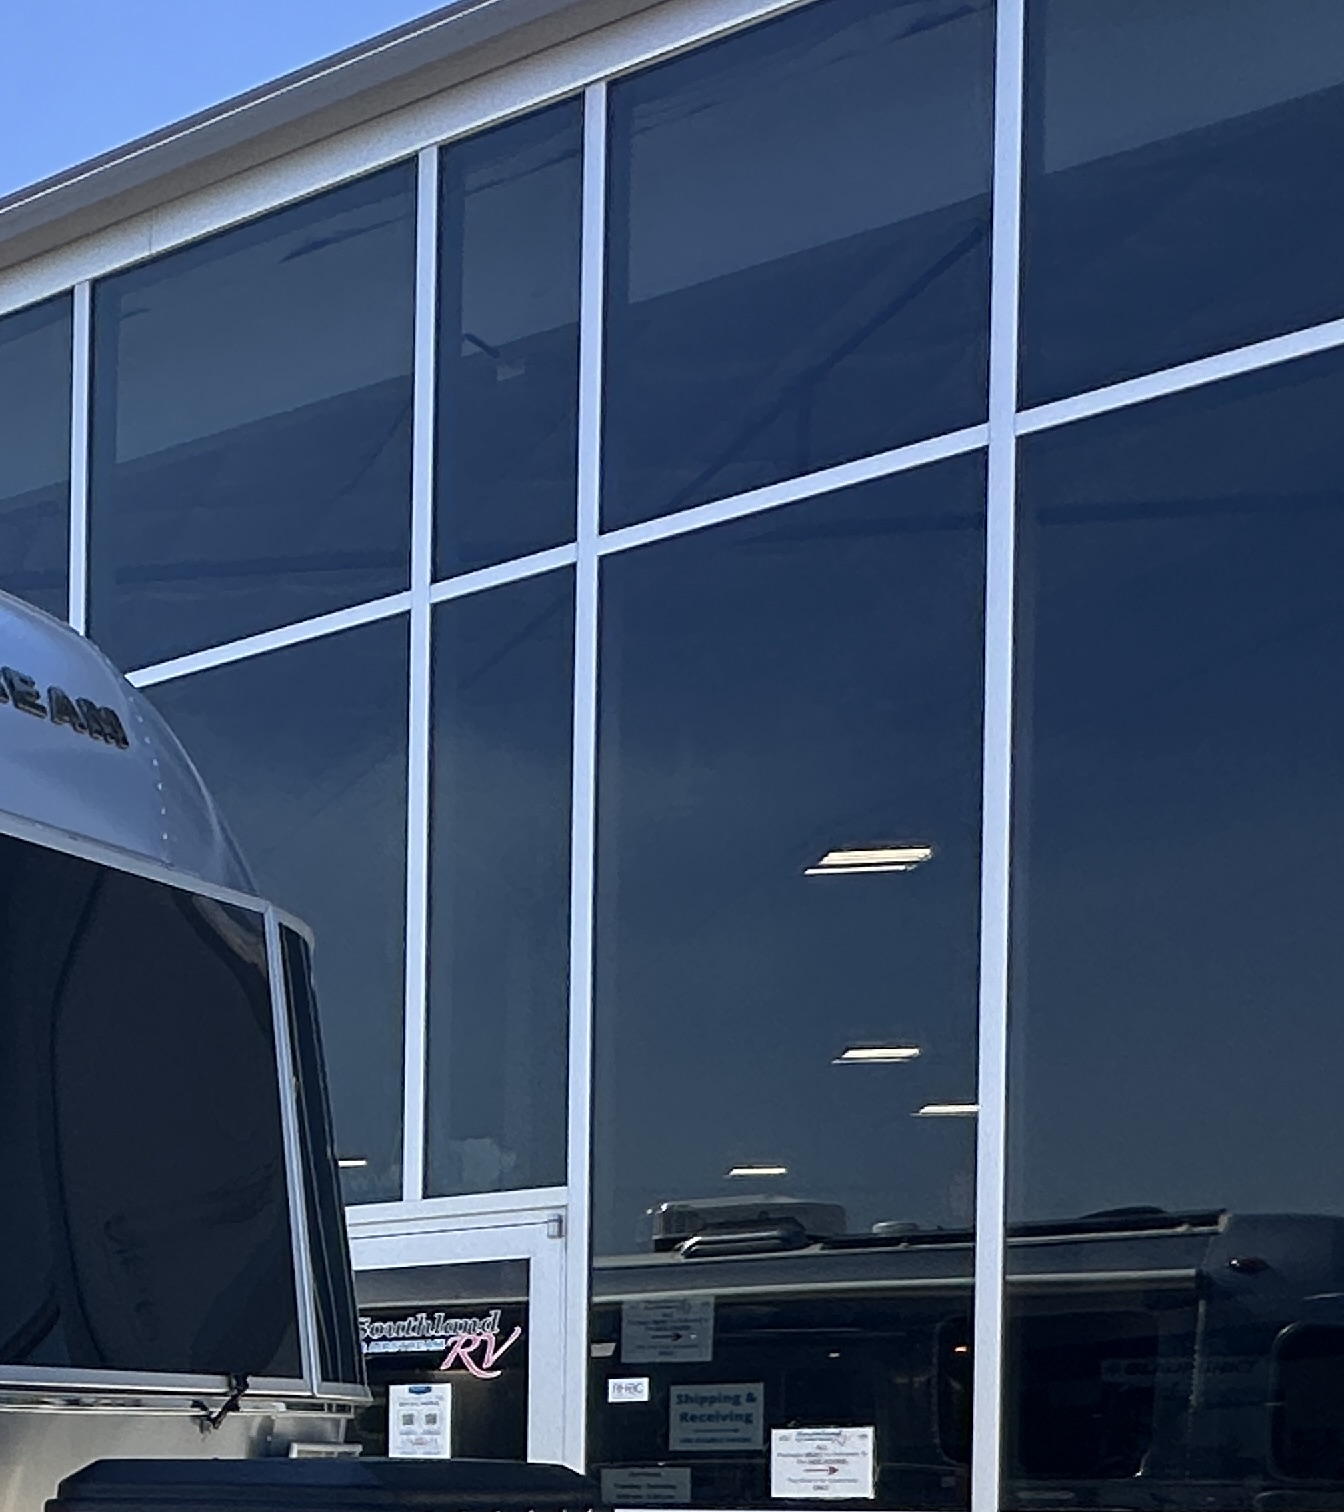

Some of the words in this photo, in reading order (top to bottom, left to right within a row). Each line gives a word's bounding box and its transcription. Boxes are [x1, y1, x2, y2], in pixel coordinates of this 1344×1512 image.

[358, 1309, 502, 1339] Southland
[439, 1326, 522, 1379] RV
[676, 1392, 742, 1408] Shipping
[746, 1391, 757, 1403] &
[679, 1410, 754, 1425] Receiving
